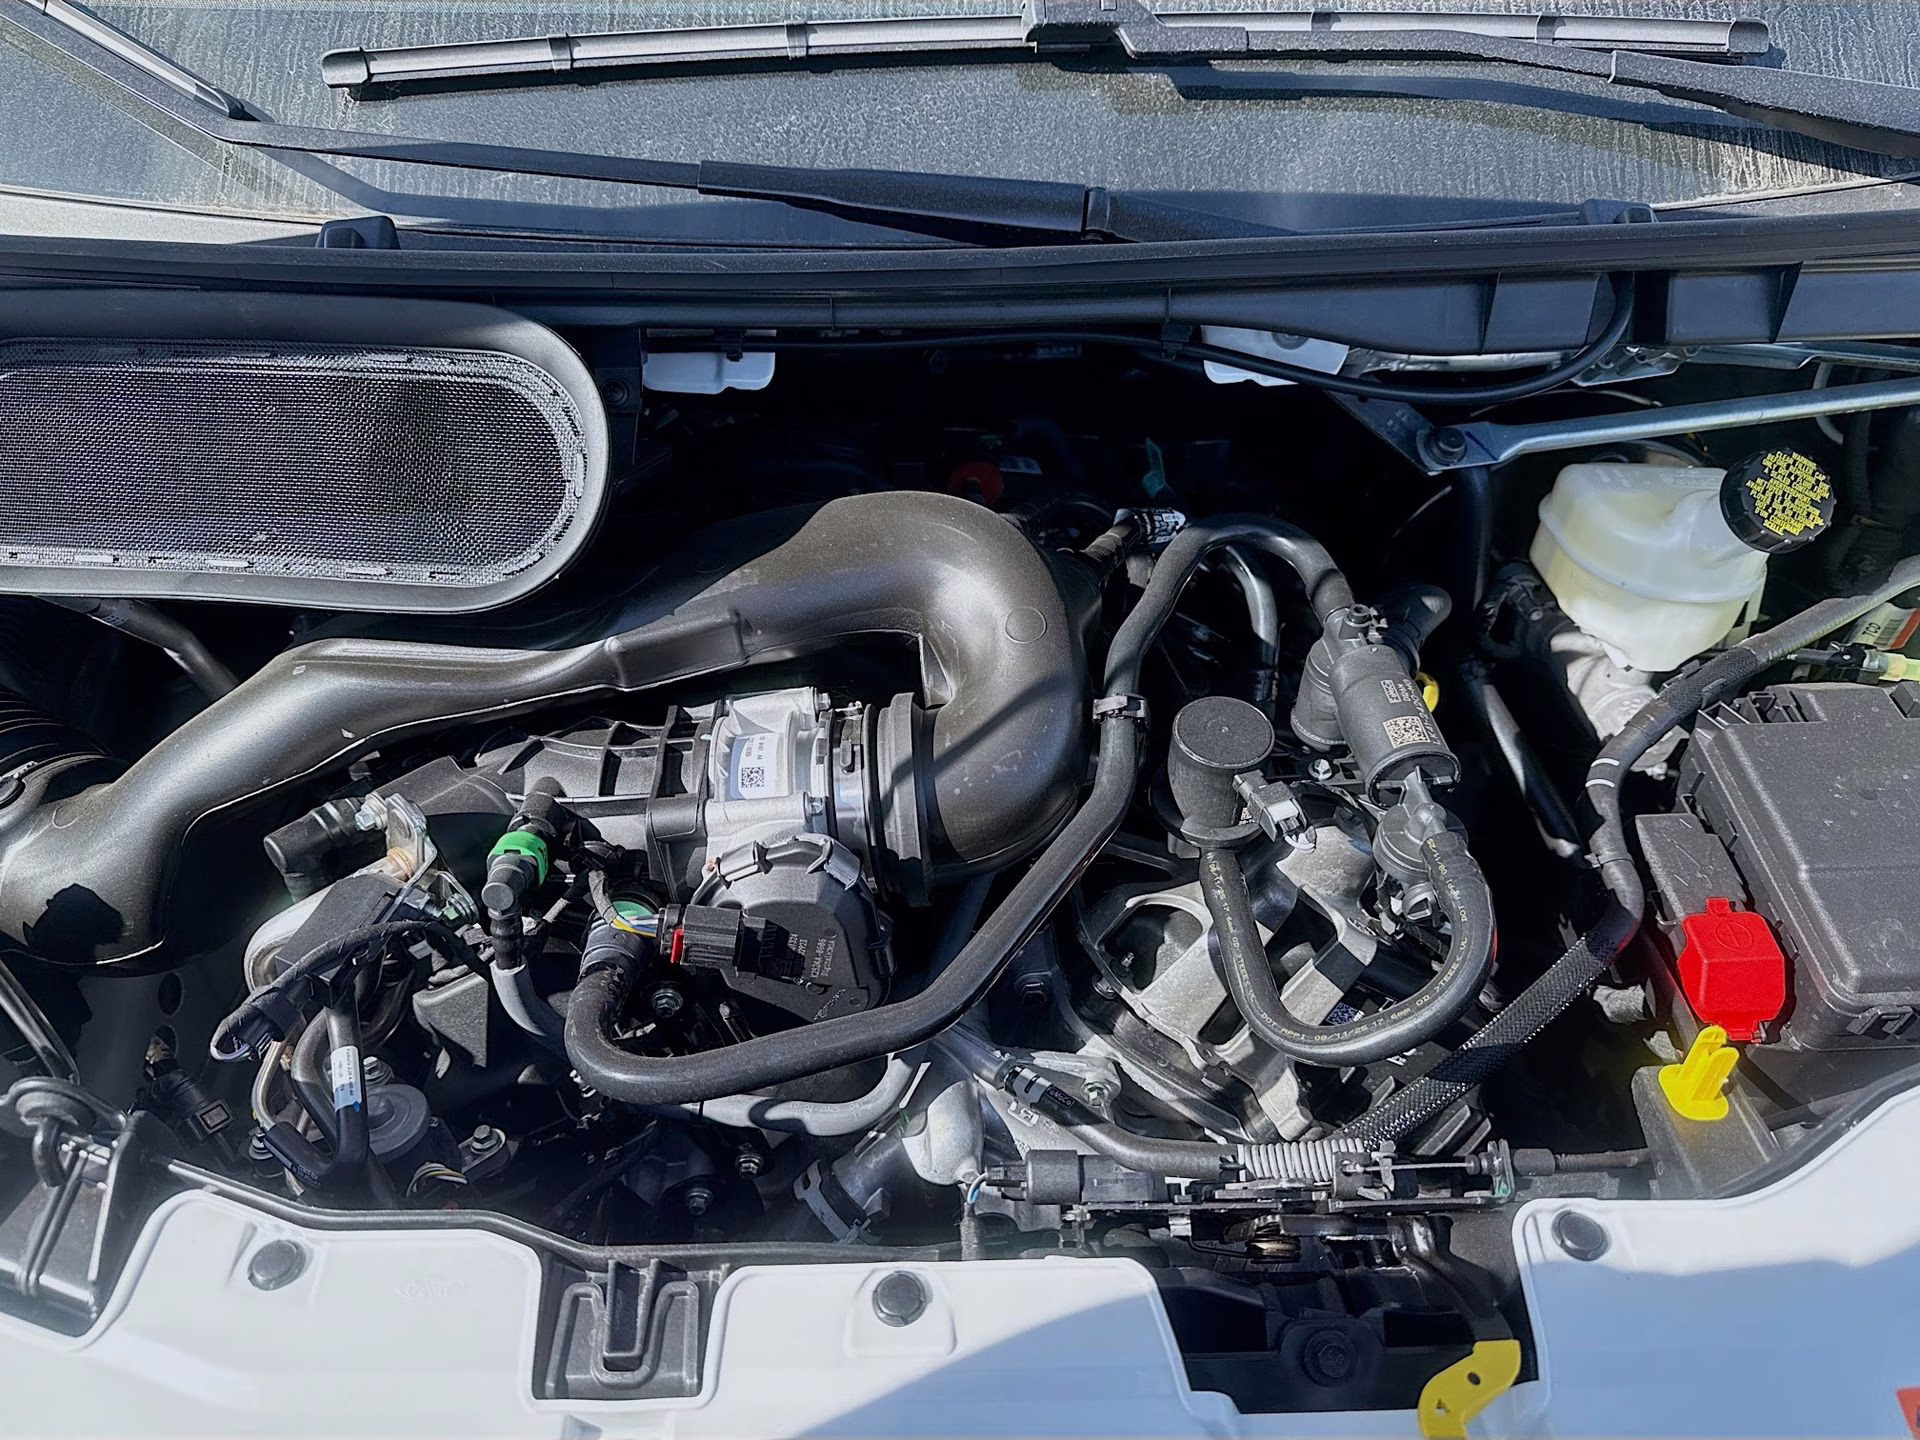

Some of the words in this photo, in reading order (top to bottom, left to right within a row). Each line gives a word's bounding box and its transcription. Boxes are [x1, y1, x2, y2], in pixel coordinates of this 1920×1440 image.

[1261, 1012, 1278, 1027] DOT
[1415, 994, 1430, 1006] OD
[1458, 905, 1468, 922] DOT
